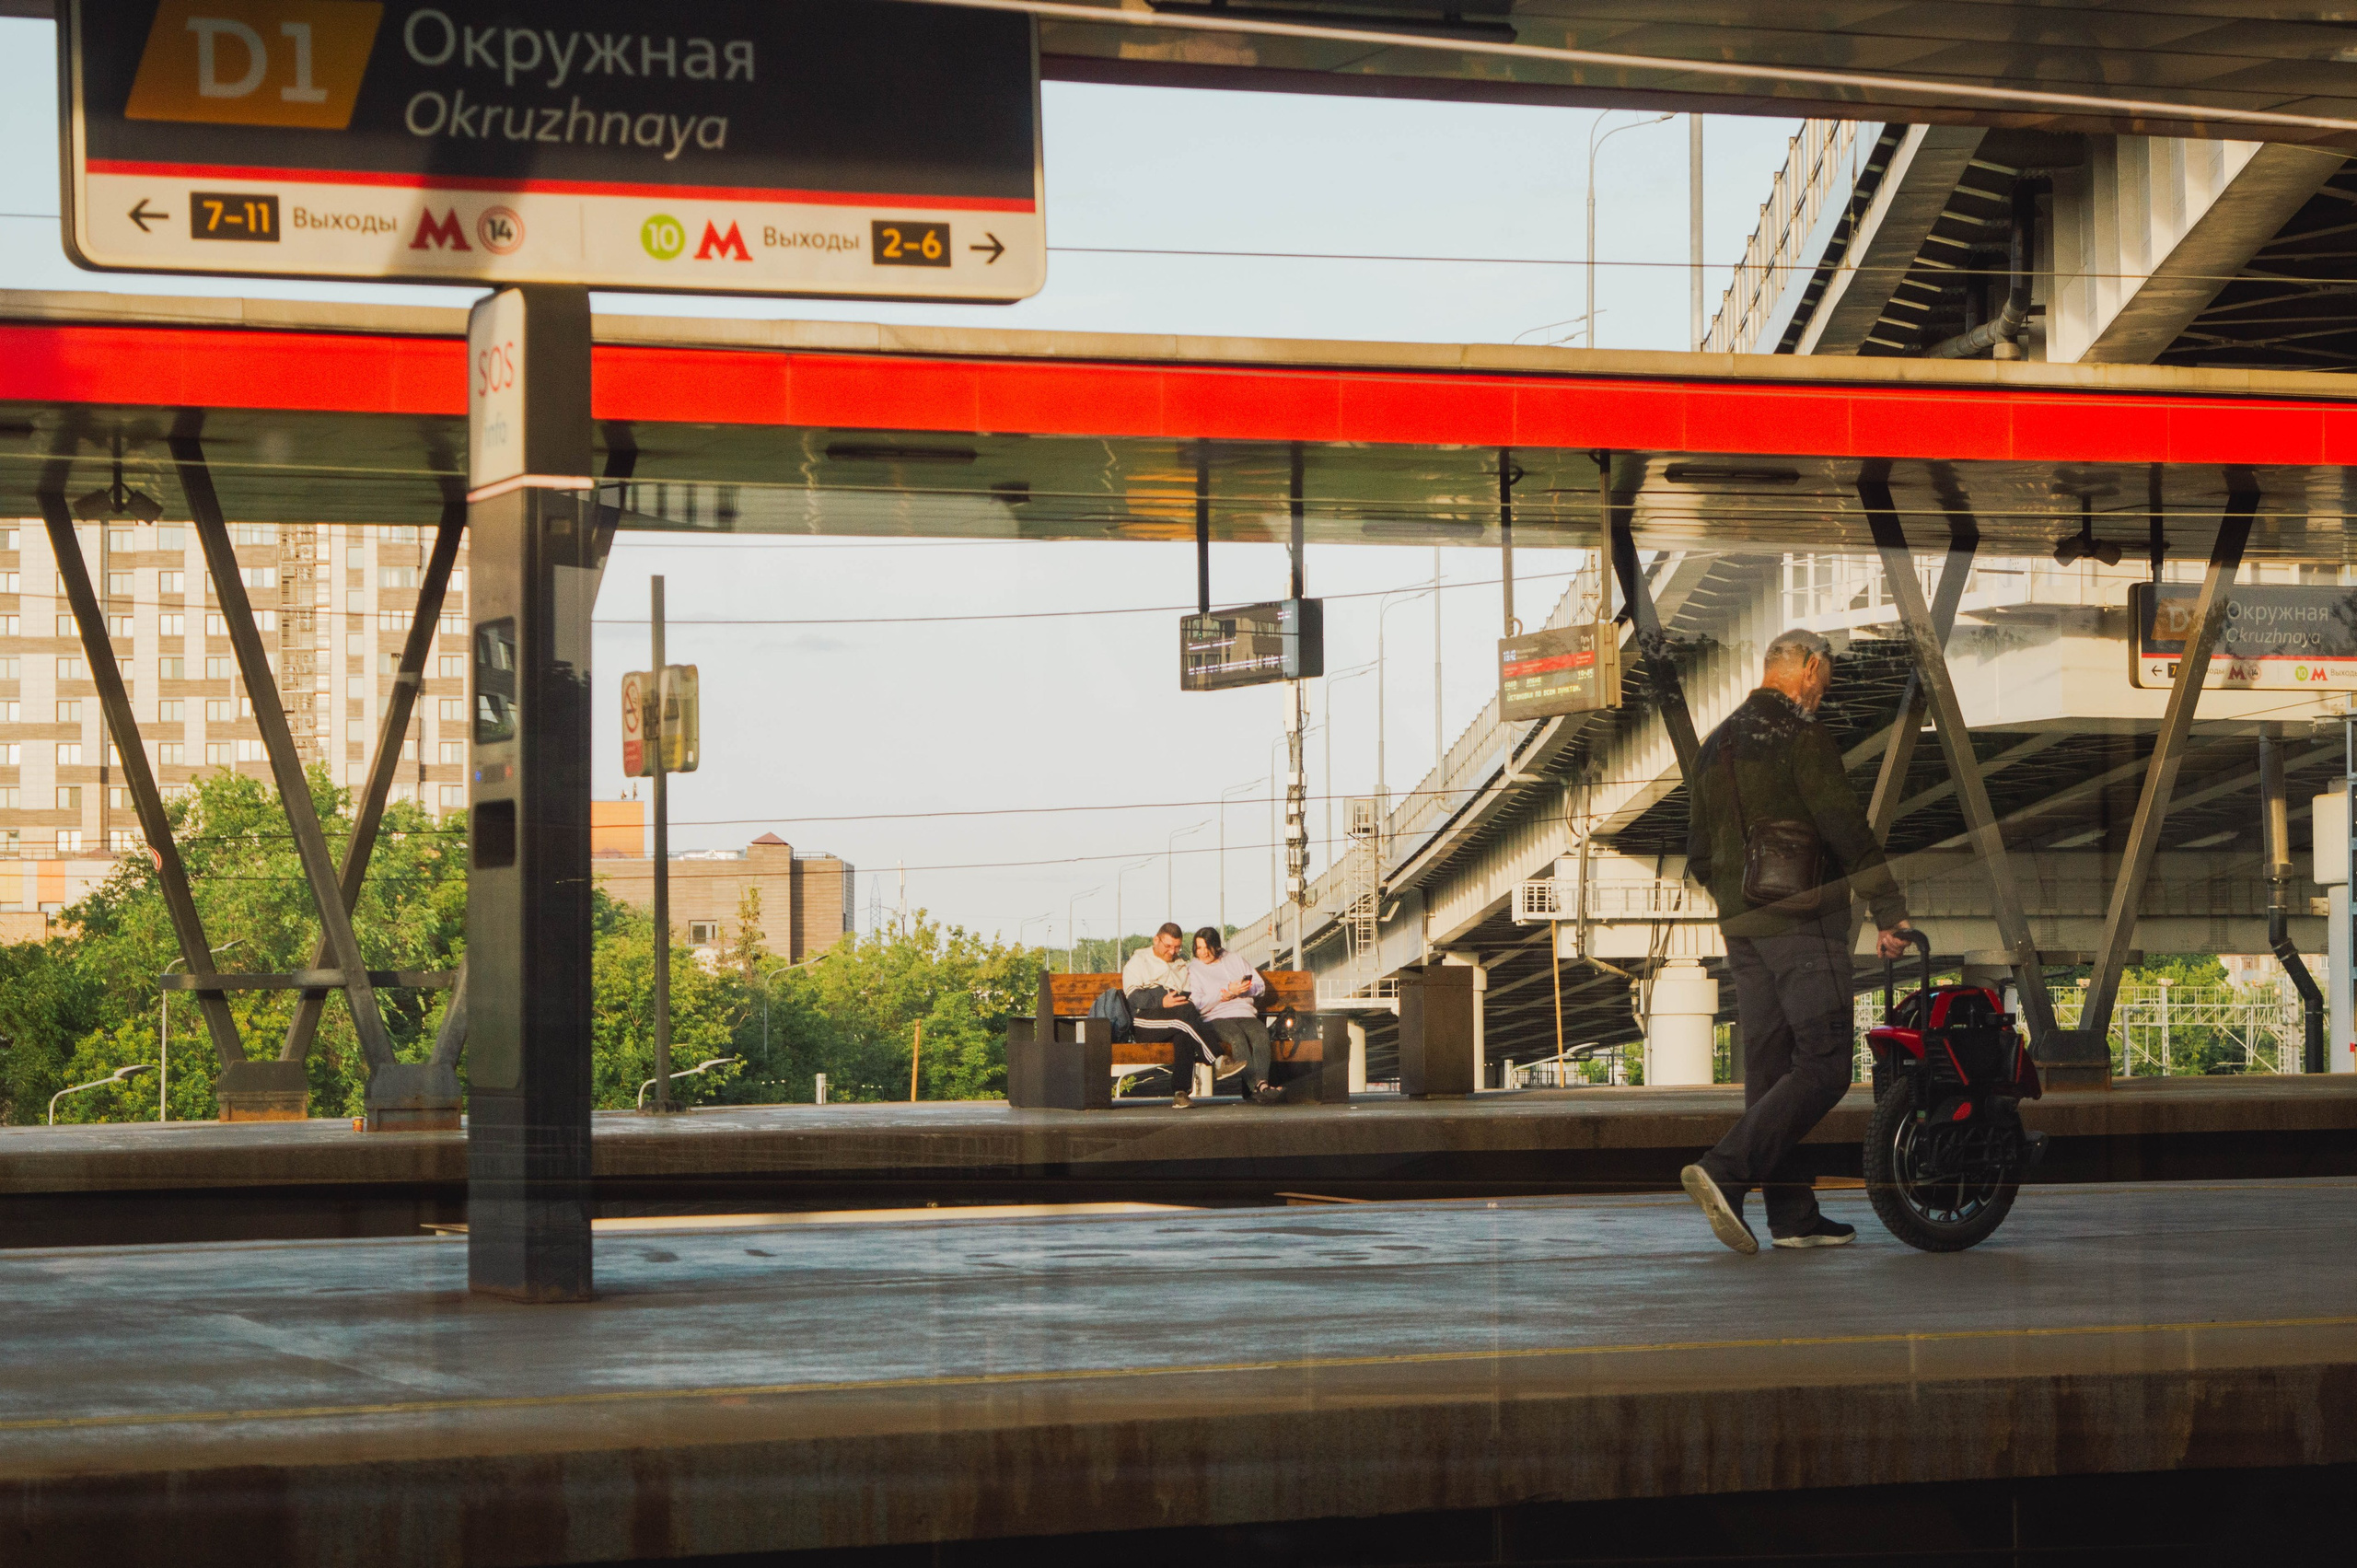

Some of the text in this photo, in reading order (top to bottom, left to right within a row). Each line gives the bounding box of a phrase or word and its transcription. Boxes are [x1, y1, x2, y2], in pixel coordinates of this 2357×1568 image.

[186, 15, 328, 105] D1
[403, 7, 756, 89] Окружная
[404, 89, 729, 161] Okruzhnaya
[292, 207, 399, 236] Выходы
[487, 219, 515, 243] 14
[647, 224, 679, 251] 10
[762, 226, 861, 252] Выходы
[478, 341, 515, 398] SOS
[2226, 600, 2329, 626] Окружная
[2226, 626, 2321, 648] Okruzhnaya
